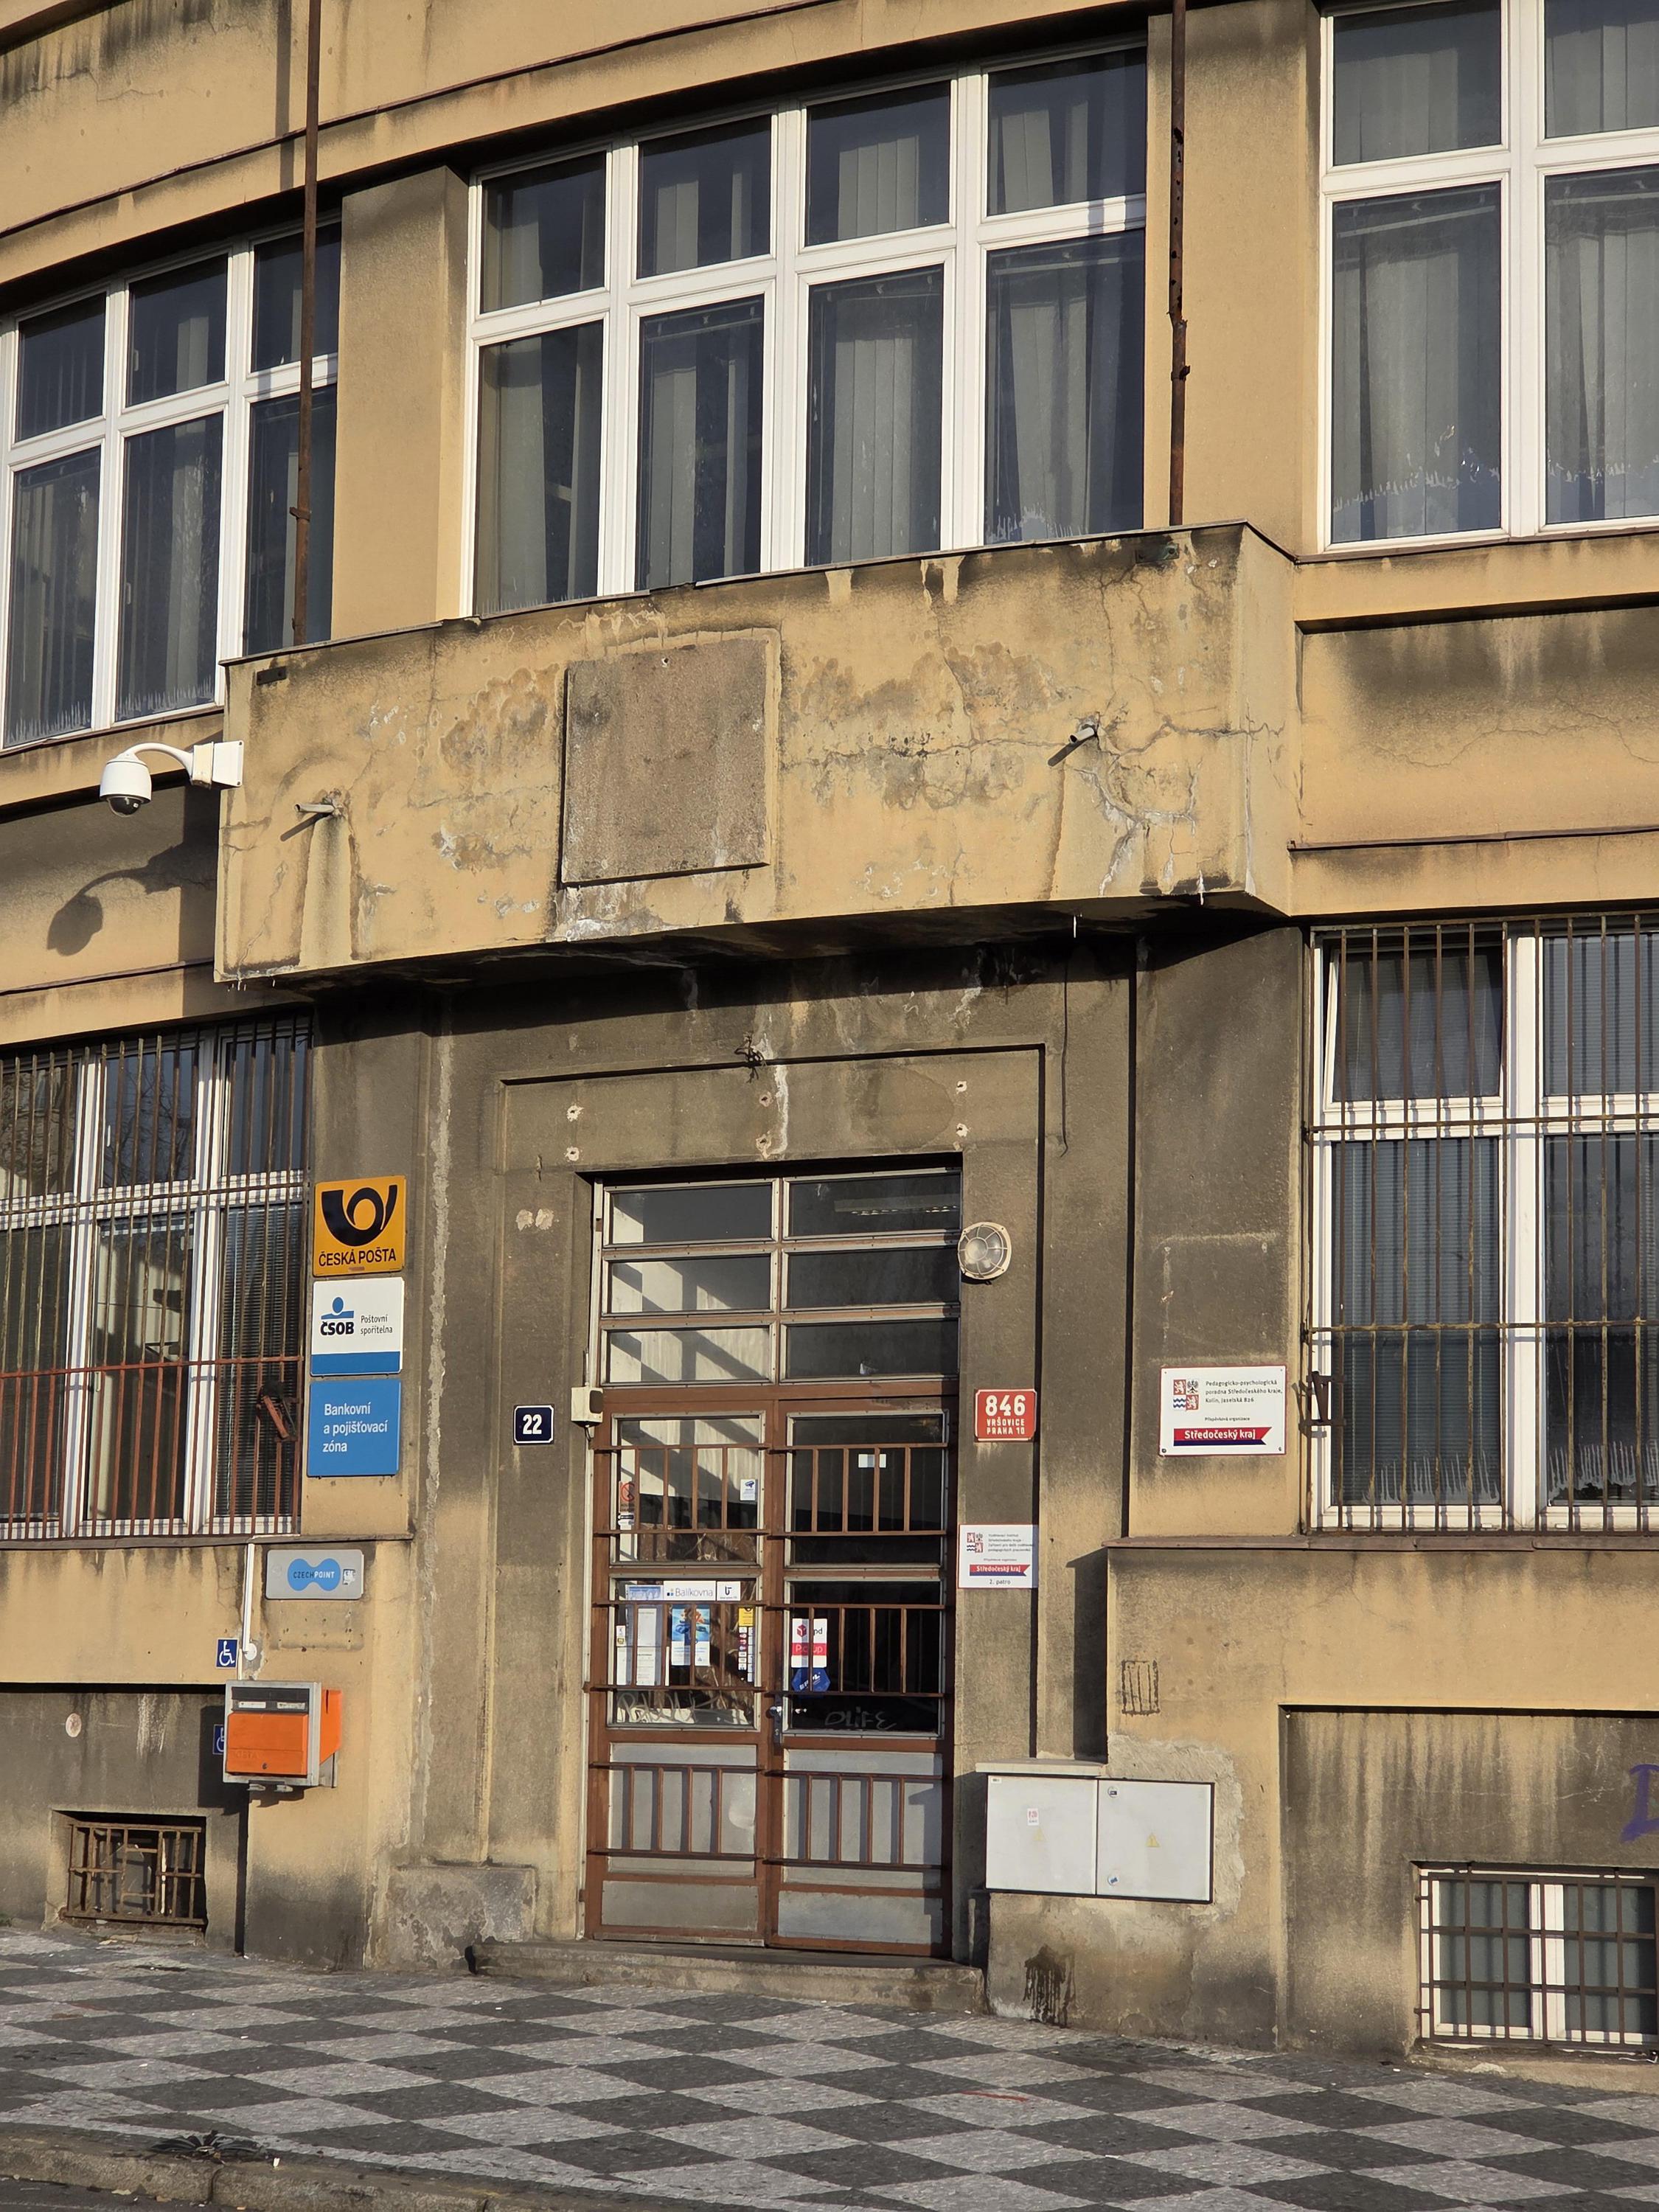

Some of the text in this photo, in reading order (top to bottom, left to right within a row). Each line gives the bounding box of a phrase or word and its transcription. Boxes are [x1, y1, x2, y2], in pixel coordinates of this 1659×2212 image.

[319, 1245, 396, 1267] ČESKÁ POŠTA
[361, 1314, 388, 1324] Poštovní
[320, 1321, 355, 1335] ČSOB
[360, 1324, 393, 1335] spořitelna
[324, 1402, 371, 1416] Bankovní
[985, 1394, 1026, 1416] 846
[523, 1414, 542, 1435] 22
[987, 1416, 1025, 1426] VRŠOVICE
[324, 1419, 388, 1438] a pojišťovací
[987, 1427, 1025, 1435] PRAHA 10
[1184, 1429, 1256, 1440] Středočeský kraj
[323, 1440, 347, 1453] zóna
[1010, 1565, 1021, 1573] kraj
[675, 1587, 713, 1597] Balíkovna
